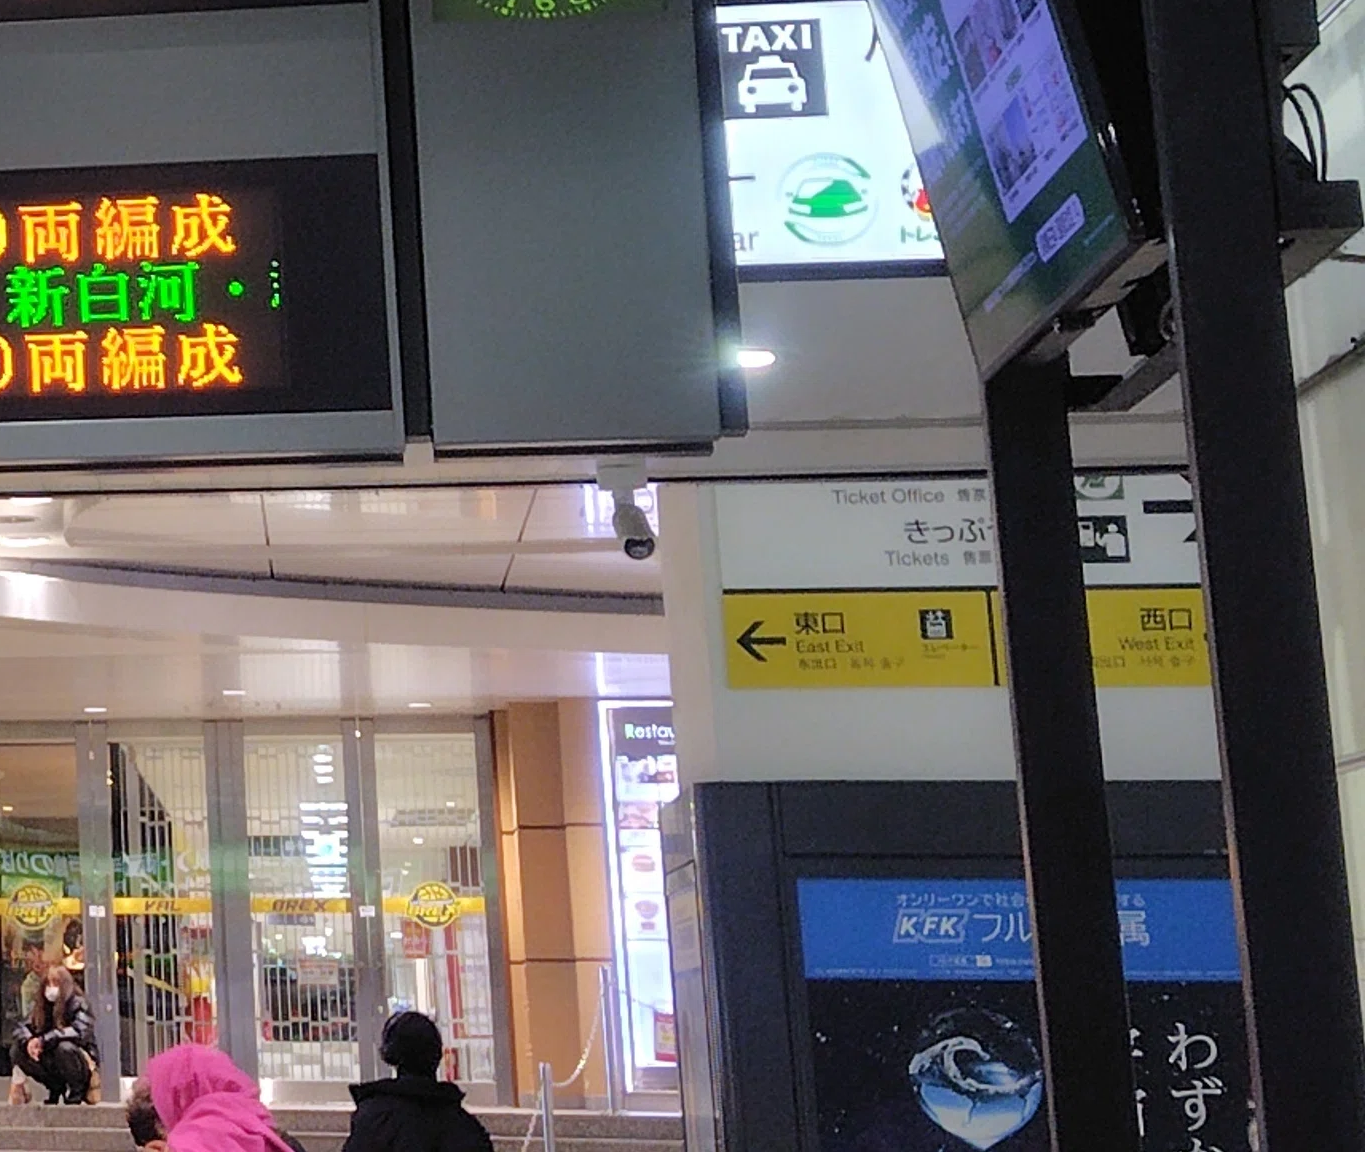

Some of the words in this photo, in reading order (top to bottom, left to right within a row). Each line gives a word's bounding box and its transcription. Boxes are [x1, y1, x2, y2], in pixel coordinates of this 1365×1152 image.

[720, 23, 813, 54] TAXI
[832, 489, 887, 505] Ticket
[891, 488, 945, 504] Office
[884, 550, 950, 567] Tickets
[794, 611, 846, 636] 東口
[1139, 608, 1192, 632] 西口
[796, 640, 830, 654] East
[835, 639, 865, 654] Exit
[1118, 635, 1159, 651] West
[1164, 635, 1195, 651] Exit
[900, 915, 959, 937] KFK
